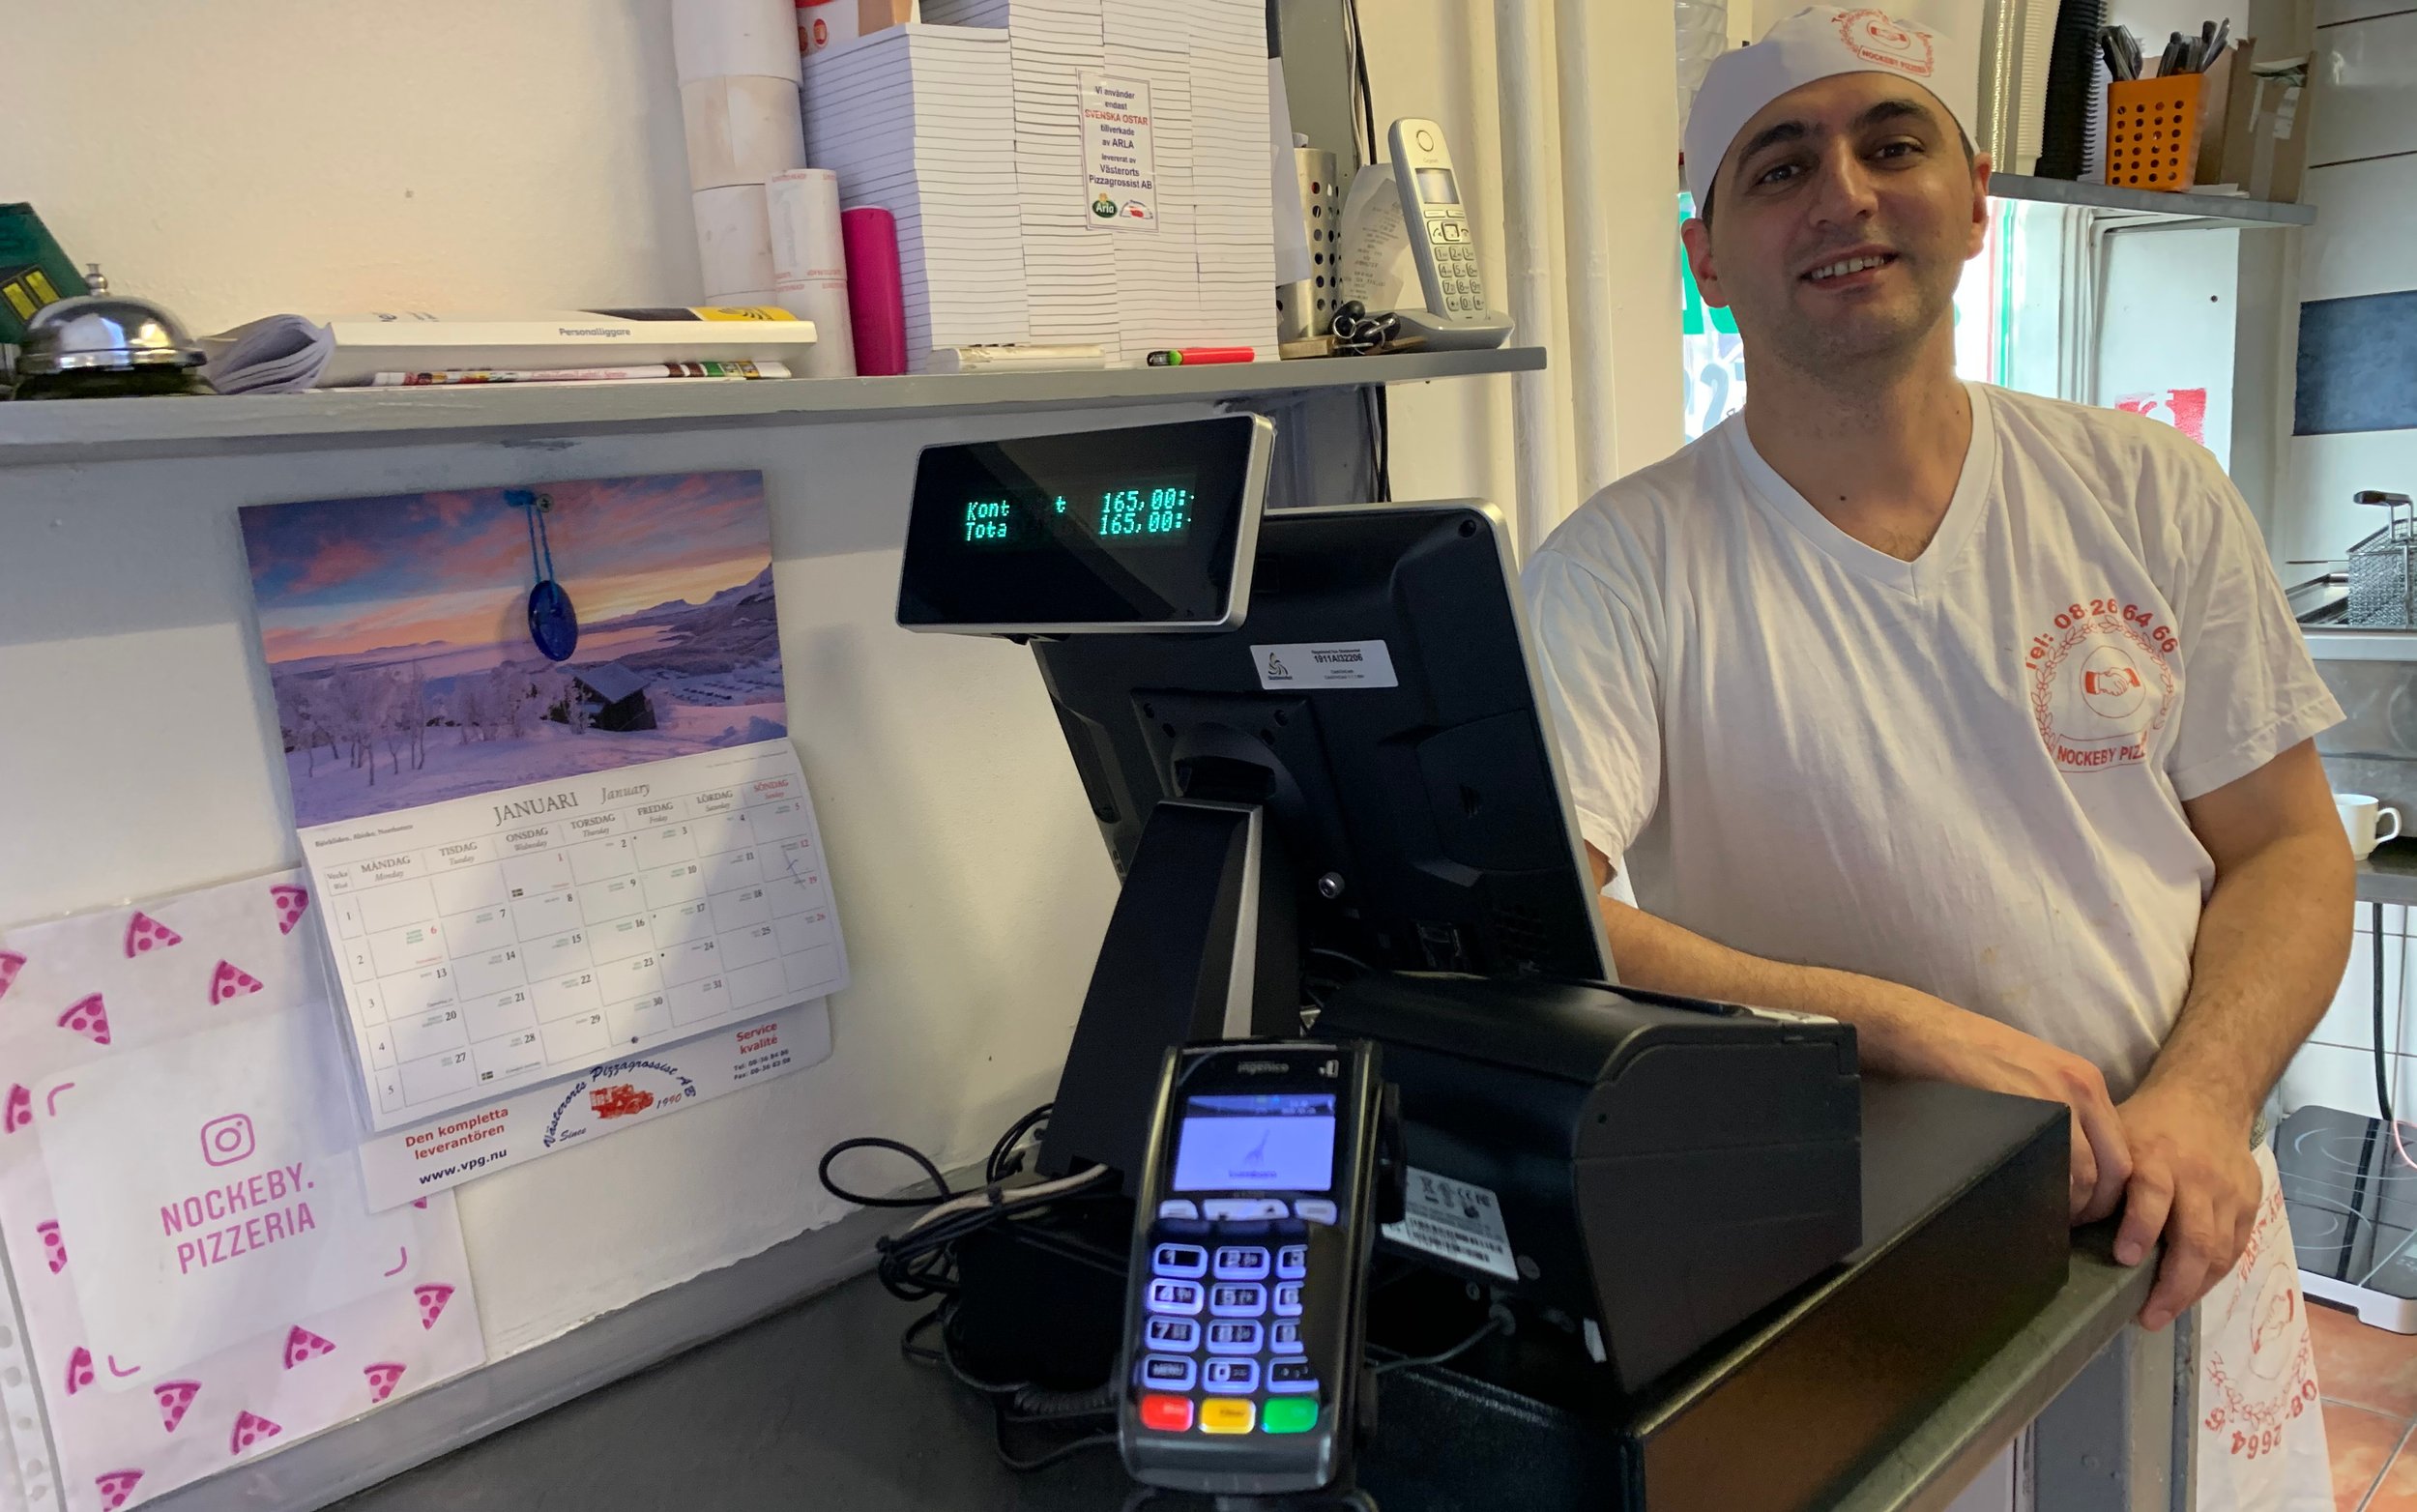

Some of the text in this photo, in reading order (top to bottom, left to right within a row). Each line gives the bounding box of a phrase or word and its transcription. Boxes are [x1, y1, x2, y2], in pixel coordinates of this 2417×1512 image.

[1104, 89, 1135, 99] använder
[1105, 102, 1127, 110] endast
[1085, 109, 1148, 126] SVENSKA OSTAR
[1100, 125, 1135, 135] tillverkade
[1101, 153, 1127, 163] levererat
[1112, 139, 1134, 149] ARLA
[1089, 175, 1152, 189] Pizzagrossist AB
[1100, 164, 1139, 176] Västerorts
[1095, 203, 1114, 214] Arla
[559, 327, 631, 337] Personalliggare
[2123, 604, 2153, 627] 64
[2152, 625, 2178, 653] 66
[2057, 745, 2115, 766] NOCKEBY
[493, 783, 651, 826] JANUARI January
[361, 856, 411, 873] MÅNDAG
[439, 842, 478, 857] TISDAG
[506, 828, 548, 842] ONSDAG
[570, 814, 616, 829] TORSDAG
[637, 802, 674, 816] FREDAG
[696, 790, 733, 804] LÖRDAG
[753, 780, 789, 792] SÖNDAG
[375, 870, 404, 882] Monday
[449, 856, 475, 865] Tuesday
[514, 841, 547, 852] Wednesday
[583, 827, 610, 838] Thursday
[649, 815, 668, 824] Friday
[706, 802, 731, 812] Saturday
[558, 853, 563, 861] 1
[621, 839, 626, 848] 2
[357, 955, 364, 965] 2
[500, 909, 506, 917] 7
[687, 865, 697, 874] 10
[801, 839, 809, 848] 12
[369, 999, 375, 1008] 3
[436, 968, 447, 978] 13
[506, 951, 515, 961] 14
[572, 934, 581, 944] 15
[635, 918, 645, 927] 16
[696, 903, 705, 913] 17
[379, 1042, 385, 1051] 4
[446, 1010, 456, 1021] 20
[515, 993, 525, 1003] 21
[580, 974, 592, 984] 22
[644, 958, 654, 967] 23
[704, 942, 713, 950] 24
[762, 927, 772, 936] 25
[388, 1086, 394, 1094] 5
[455, 1052, 467, 1063] 27
[524, 1033, 536, 1043] 28
[591, 1014, 600, 1025] 29
[653, 997, 663, 1005] 30
[736, 1023, 777, 1042] Service
[543, 1081, 587, 1148] Västerorts
[590, 1061, 679, 1082] Pizzagrossist
[560, 1093, 683, 1142] Since 1990
[405, 1108, 509, 1147] Den kompletta
[415, 1124, 505, 1160] leverantören
[420, 1149, 507, 1184] www.vpg.nu
[160, 1162, 314, 1236] NOCKEBY.
[177, 1202, 315, 1274] PIZZERIA
